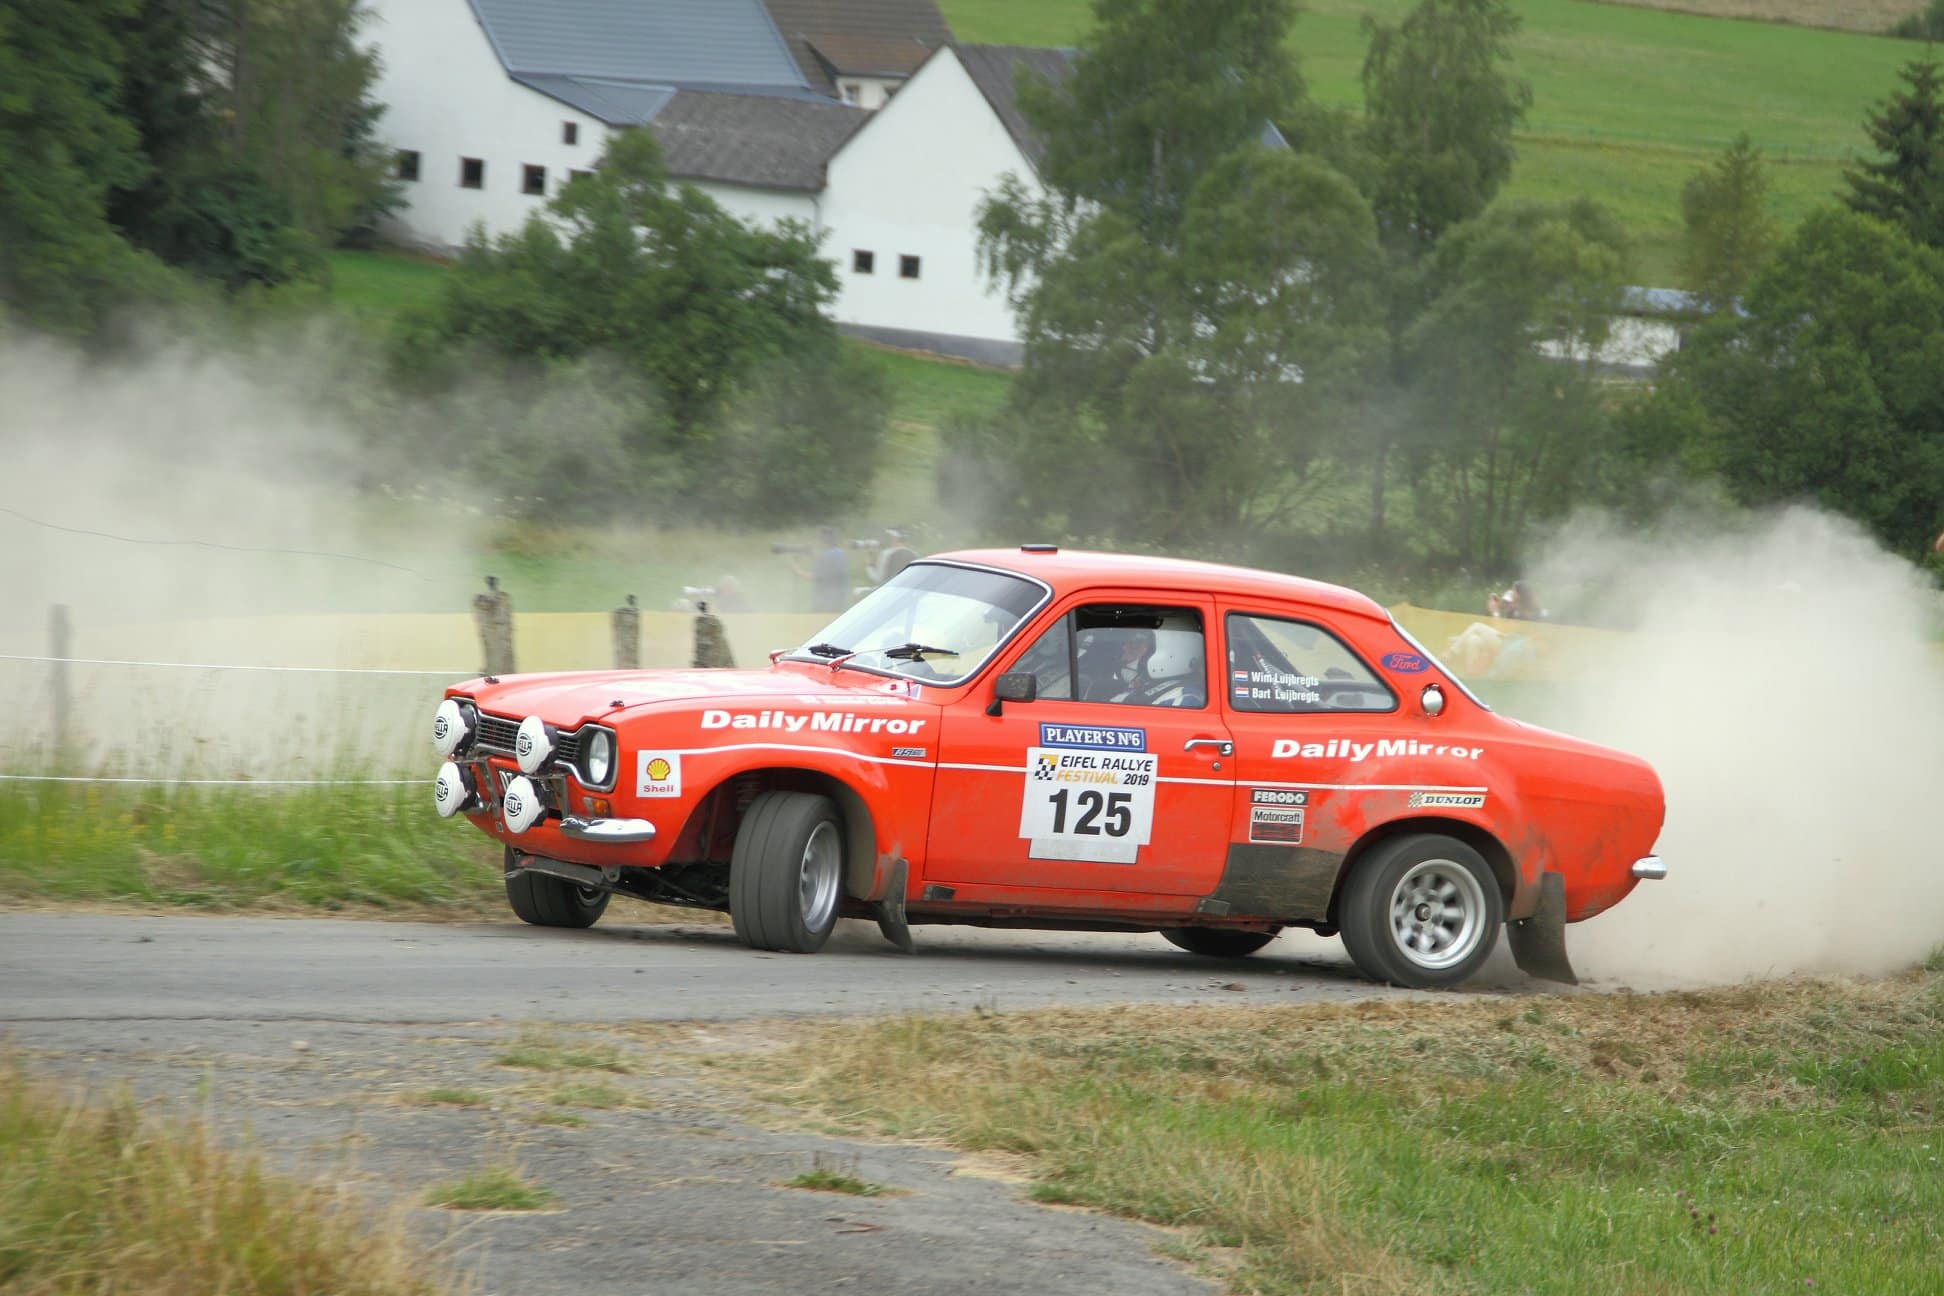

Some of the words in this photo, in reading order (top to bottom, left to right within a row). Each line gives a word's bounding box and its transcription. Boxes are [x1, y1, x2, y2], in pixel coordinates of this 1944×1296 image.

[1390, 655, 1421, 670] Ford
[1251, 671, 1272, 683] Wim
[1274, 672, 1319, 687] Luijbregts
[1252, 687, 1271, 699] Bart
[1046, 727, 1115, 745] PLAYER'S
[1061, 755, 1097, 769] EIFEL
[1101, 757, 1153, 772] RALLYE
[1056, 770, 1118, 785] FESTIVAL
[1123, 773, 1149, 786] 2019
[643, 784, 674, 793] Shell
[1254, 791, 1305, 804] FERODO
[1423, 795, 1482, 805] DUNLOP
[1048, 788, 1132, 837] 125
[1254, 811, 1300, 823] Motorcraft
